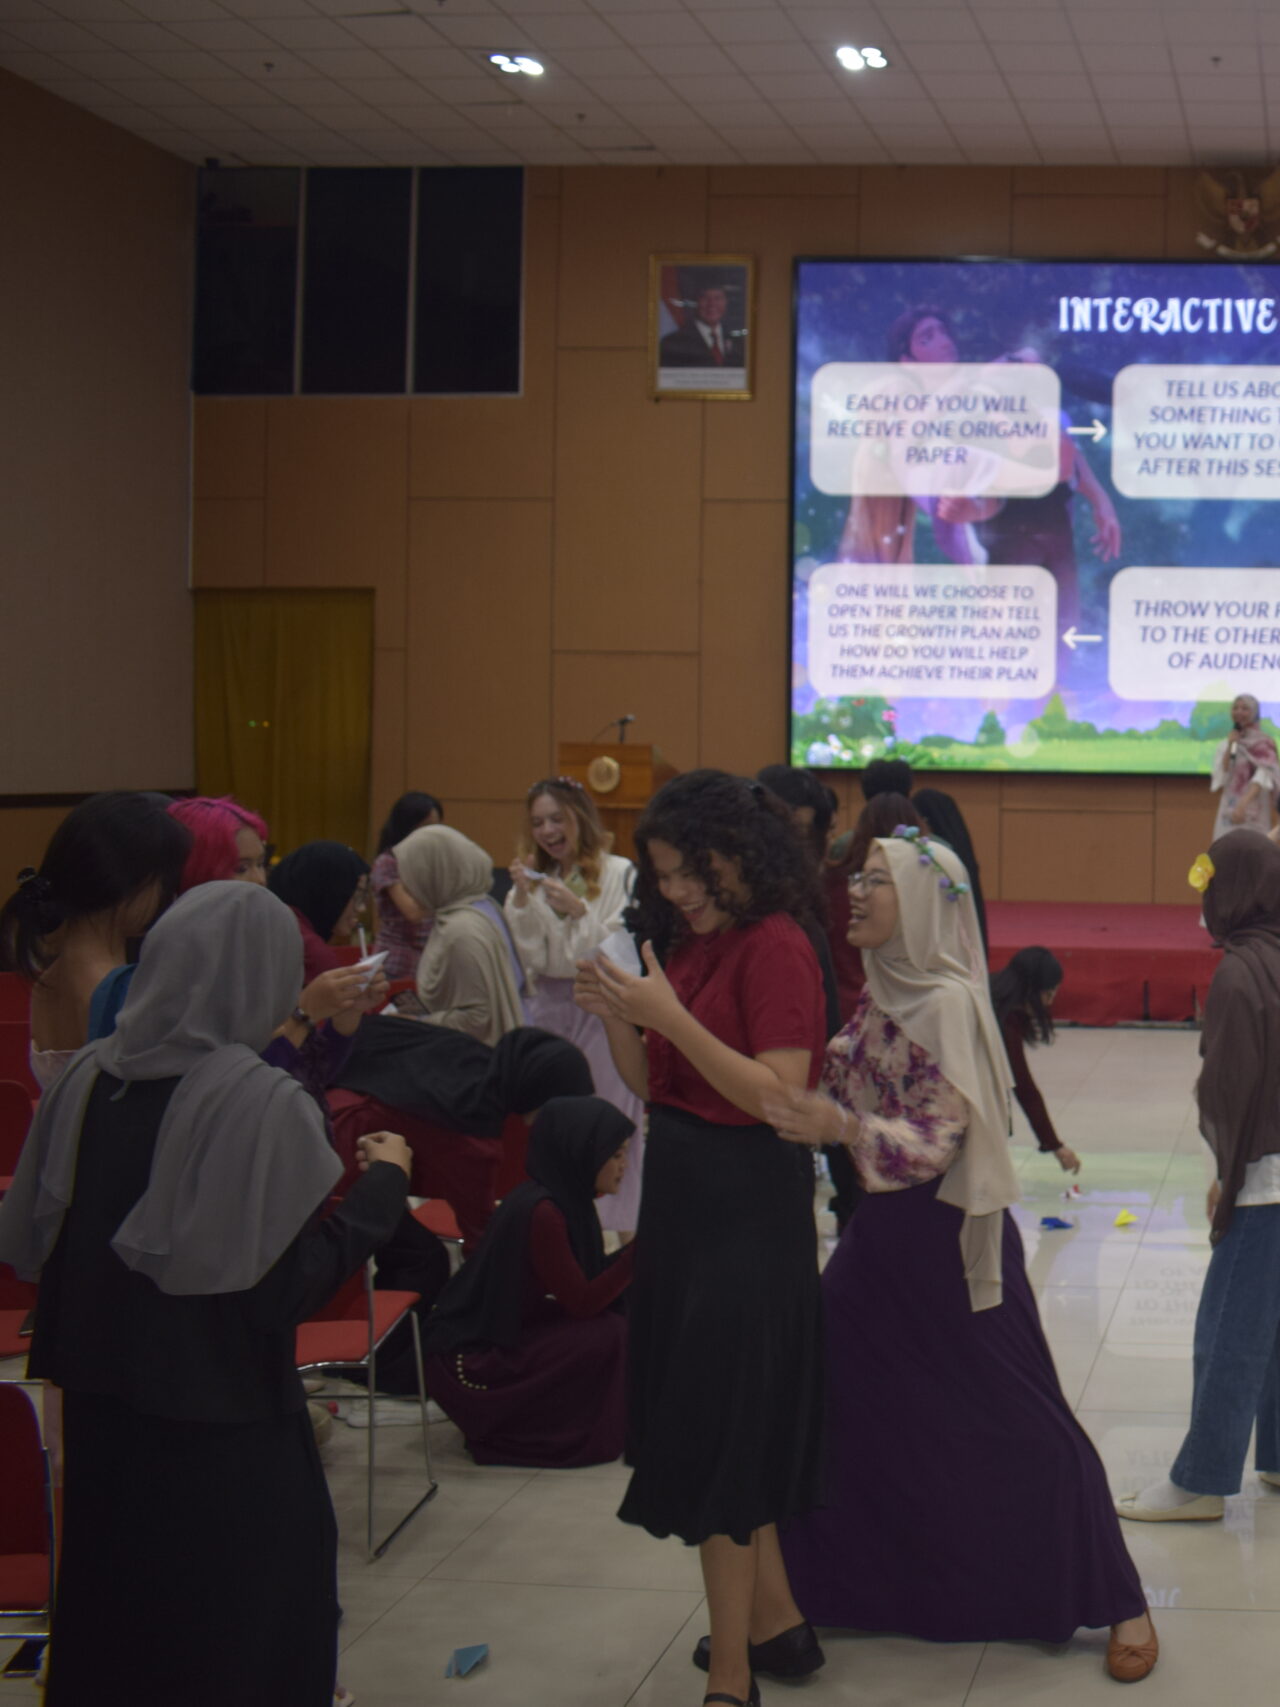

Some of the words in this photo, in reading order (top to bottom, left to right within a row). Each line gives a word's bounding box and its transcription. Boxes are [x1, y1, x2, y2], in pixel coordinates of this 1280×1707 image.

[1059, 297, 1276, 335] INTERACTIVE
[1165, 380, 1209, 397] TELL
[1213, 380, 1239, 397] US
[846, 394, 898, 412] EACH
[903, 394, 931, 412] OF
[935, 395, 977, 412] YOU
[982, 395, 1027, 413] WILL
[1149, 406, 1275, 424] SOMETHING
[827, 420, 909, 437] RECEIVE
[913, 420, 957, 438] ONE
[961, 421, 1048, 438] ORIGAMI
[1134, 432, 1176, 450] YOU
[1181, 432, 1245, 450] WANT
[1248, 433, 1280, 450] TO
[905, 447, 967, 464] PAPER
[1138, 458, 1202, 475] AFTER
[1205, 459, 1249, 476] THIS
[835, 584, 868, 599] ONE
[873, 584, 910, 599] WILL
[914, 584, 939, 599] WE
[942, 585, 1008, 599] CHOOSE
[1012, 585, 1035, 600] TO
[828, 604, 871, 619] OPEN
[876, 604, 905, 619] THE
[909, 605, 957, 619] PAPER
[961, 605, 1005, 620] THEN
[1008, 605, 1041, 620] TELL
[1134, 600, 1210, 617] THROW
[1214, 600, 1271, 618] YOUR
[828, 624, 849, 638] US
[853, 624, 881, 639] THE
[884, 624, 957, 639] GROWTH
[961, 624, 1001, 639] PLAN
[1004, 625, 1041, 639] AND
[1140, 626, 1168, 643] TO
[1172, 626, 1211, 644] THE
[840, 644, 879, 659] HOW
[883, 644, 908, 659] DO
[912, 645, 945, 659] YOU
[949, 645, 986, 659] WILL
[989, 645, 1029, 660] HELP
[1168, 652, 1195, 669] OF
[830, 665, 874, 679] THEM
[877, 665, 945, 680] ACHIEVE
[949, 666, 994, 680] THEIR
[998, 666, 1038, 681] PLAN
